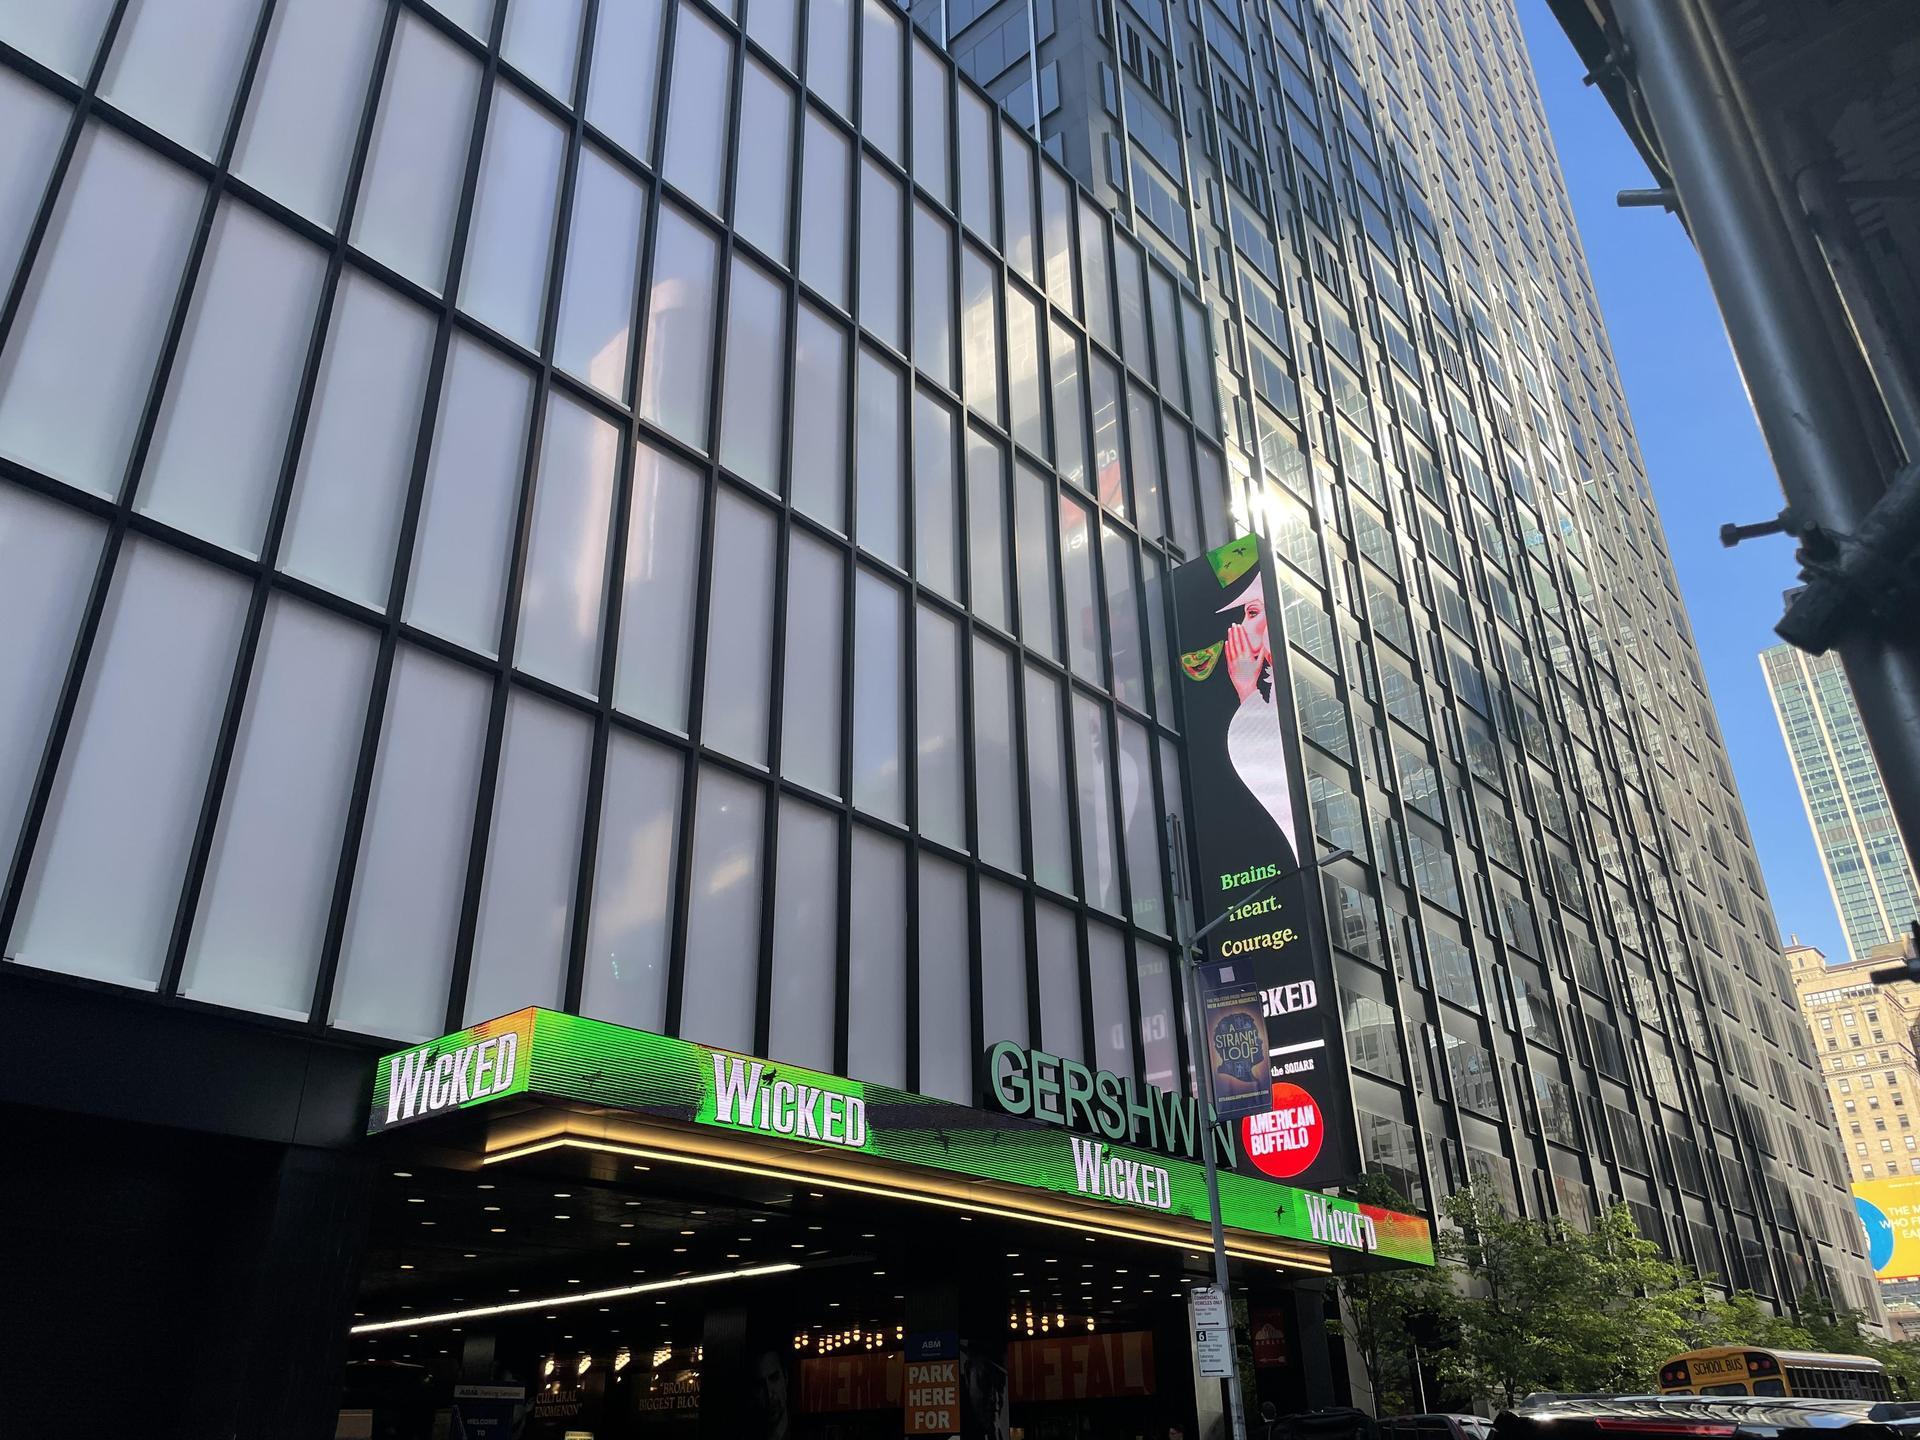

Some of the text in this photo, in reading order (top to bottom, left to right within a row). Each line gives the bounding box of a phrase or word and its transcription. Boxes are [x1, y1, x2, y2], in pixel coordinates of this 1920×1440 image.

[1220, 864, 1282, 891] Brains.
[1221, 928, 1298, 958] Courage.
[1229, 1024, 1236, 1032] A
[1215, 1029, 1259, 1049] STRANGE
[1222, 1041, 1259, 1062] LOOP
[1284, 1059, 1315, 1075] SQUARE
[1250, 1105, 1316, 1136] AMERICAN
[1251, 1127, 1309, 1157] BUFFALO
[1887, 1205, 1910, 1216] THE
[1879, 1217, 1908, 1229] WHO
[921, 1340, 941, 1349] ABM
[909, 1364, 955, 1385] PARK
[1693, 1358, 1744, 1376] SCHOOL BUS
[677, 1395, 701, 1409] BLOC
[909, 1387, 955, 1407] HERE
[914, 1410, 951, 1430] FOR
